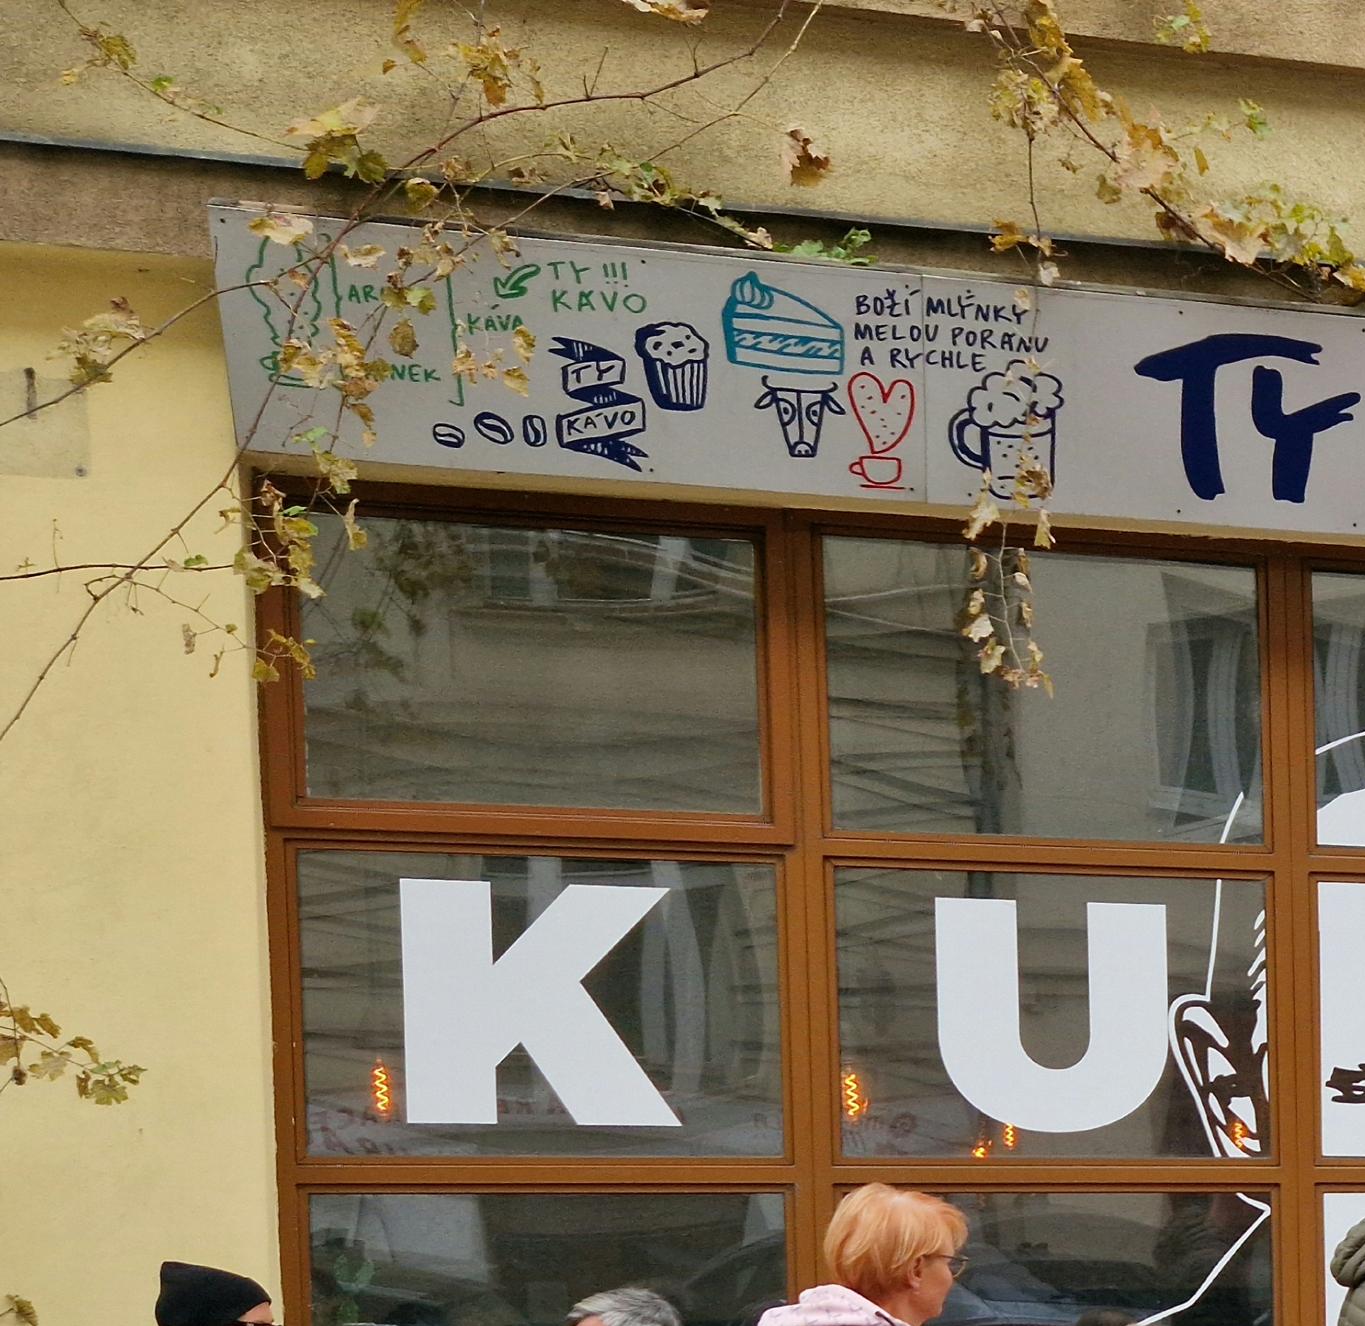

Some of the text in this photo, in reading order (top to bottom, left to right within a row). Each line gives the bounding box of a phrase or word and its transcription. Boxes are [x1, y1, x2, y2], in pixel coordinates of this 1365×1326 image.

[855, 284, 921, 316] BOŽÍ
[854, 322, 939, 342] MELOU
[860, 346, 986, 372] A RYCHLE
[570, 361, 615, 384] TY
[566, 410, 636, 435] KÁVO
